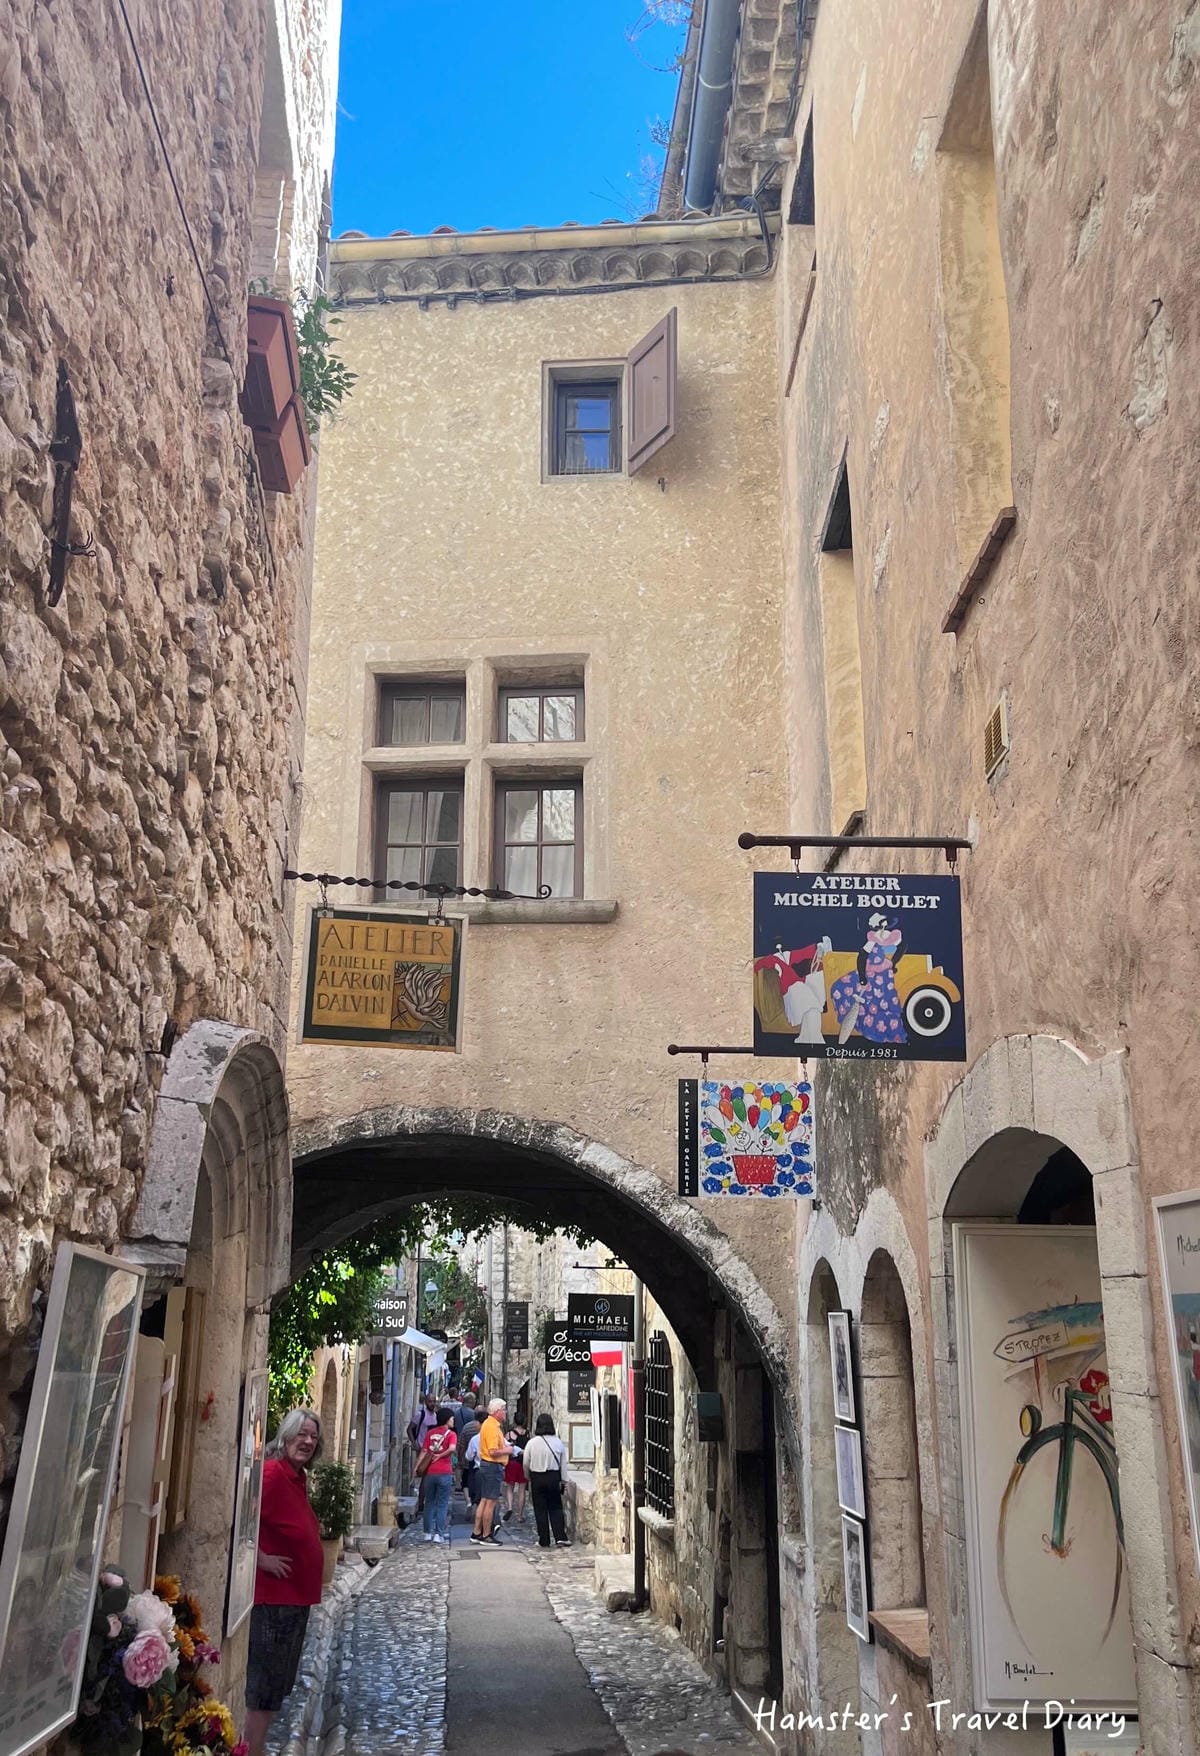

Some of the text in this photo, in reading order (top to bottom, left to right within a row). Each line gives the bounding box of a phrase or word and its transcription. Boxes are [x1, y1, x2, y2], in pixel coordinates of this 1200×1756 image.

[811, 876, 901, 891] ATELIER
[774, 893, 941, 909] MICHEL BOULET
[321, 923, 448, 957] ATELIER
[320, 954, 386, 971] DANIELLE
[318, 970, 391, 991] ALARCON
[316, 992, 385, 1014] DALVIN
[825, 1046, 898, 1060] Depuis 1981
[684, 1081, 690, 1094] LA
[385, 1315, 405, 1328] Sud
[573, 1315, 629, 1325] MICHAEL
[547, 1344, 591, 1362] Déco
